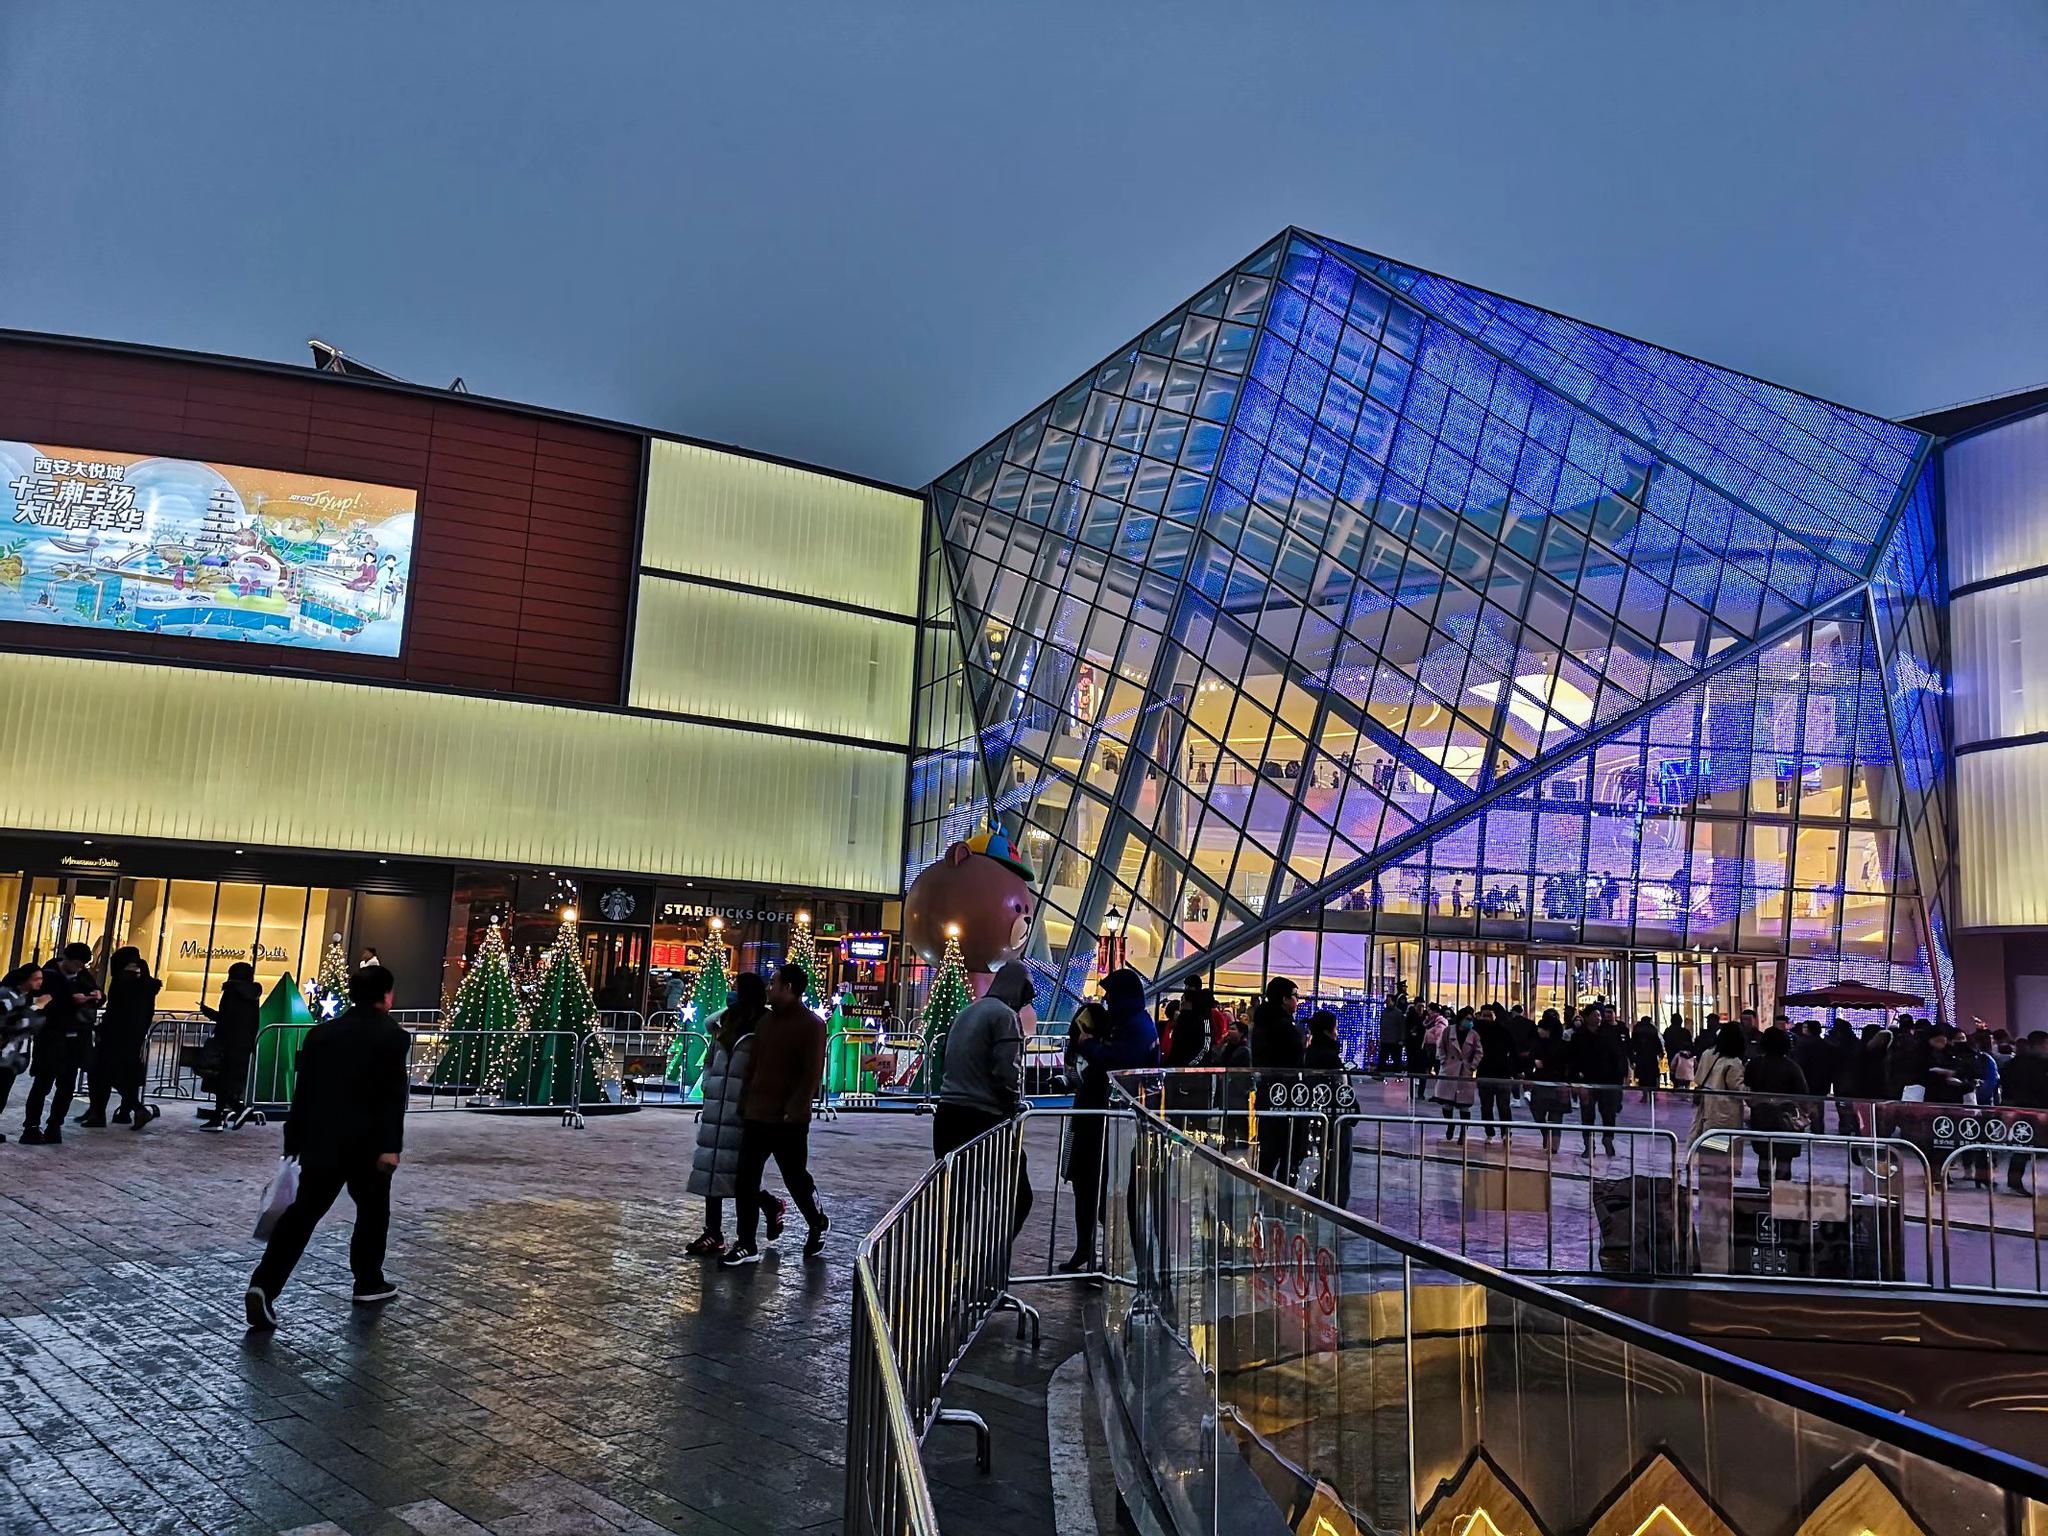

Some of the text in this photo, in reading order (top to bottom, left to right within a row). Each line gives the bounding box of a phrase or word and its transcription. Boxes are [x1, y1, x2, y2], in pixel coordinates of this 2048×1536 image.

[34, 457, 125, 481] 西安大悦城
[9, 475, 135, 510] 十三潮主场
[13, 501, 144, 532] 大悦嘉年华
[664, 903, 797, 923] STARBUCKS COFF
